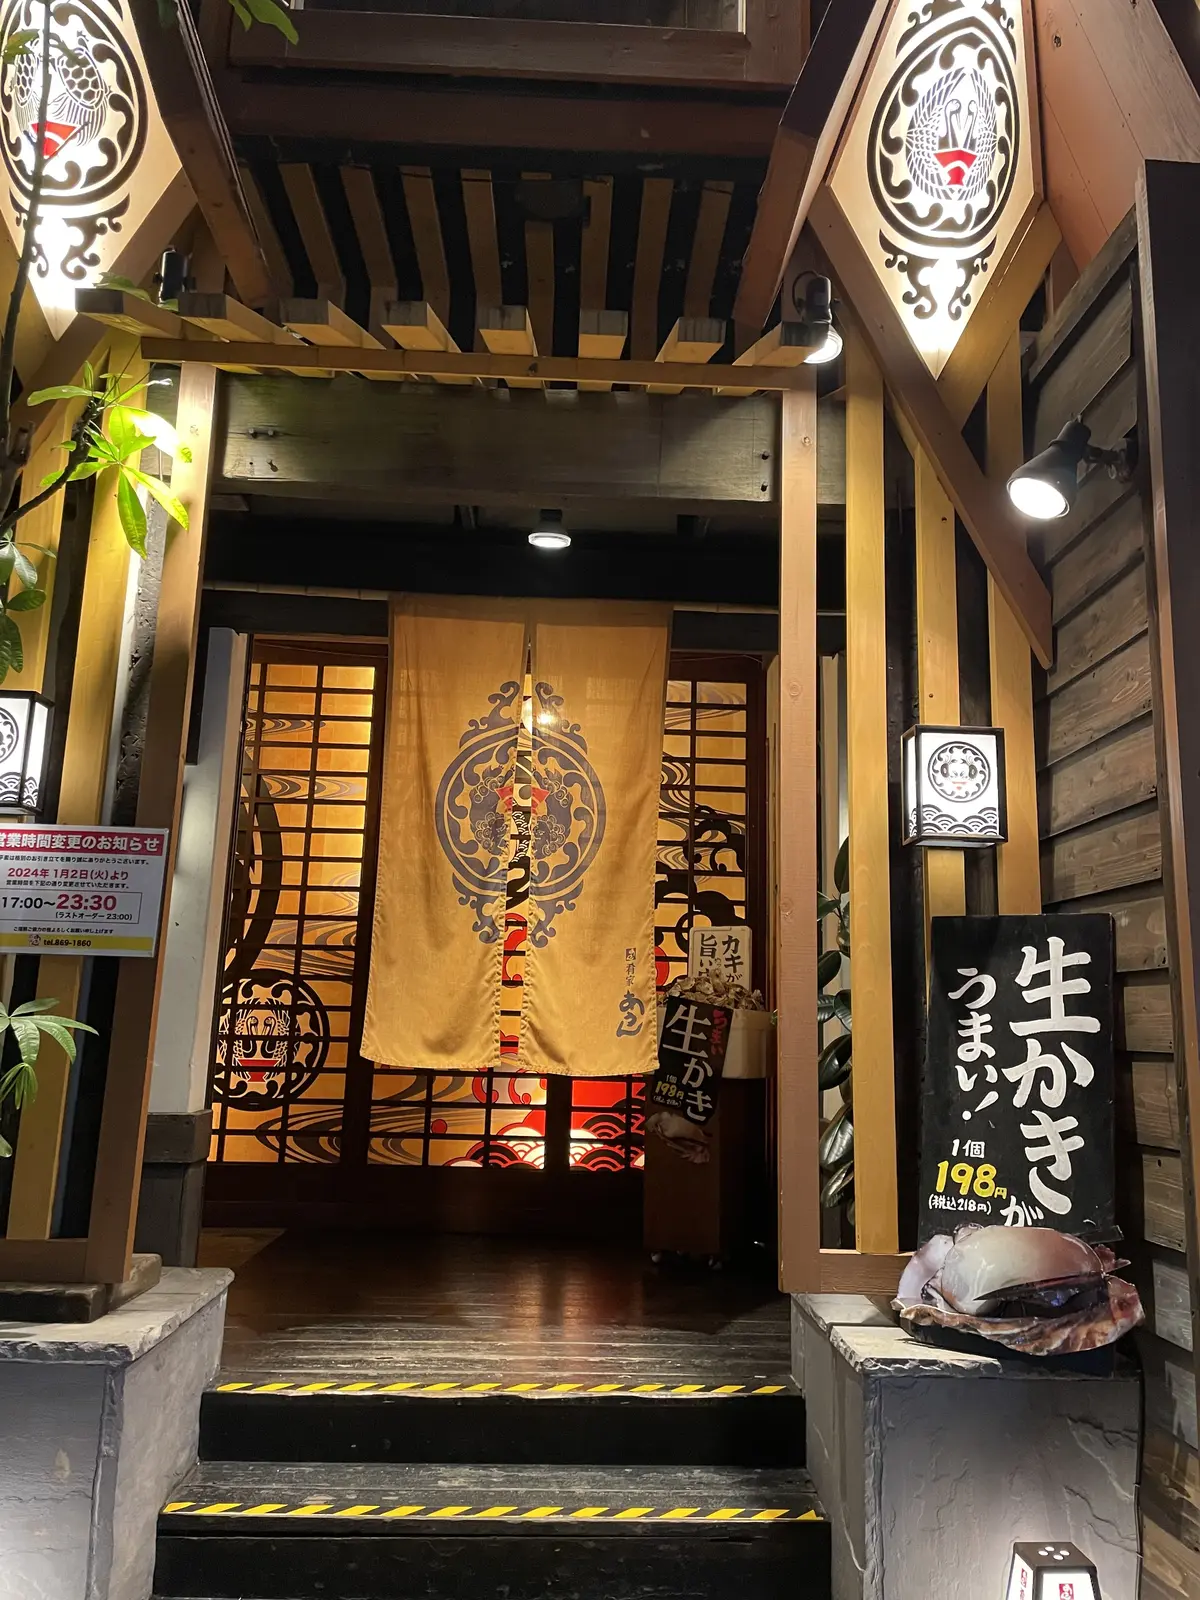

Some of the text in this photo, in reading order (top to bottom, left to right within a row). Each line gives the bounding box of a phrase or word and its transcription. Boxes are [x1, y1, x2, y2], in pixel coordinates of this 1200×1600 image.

[722, 935, 744, 982] カキが
[662, 1004, 714, 1122] 生かき
[948, 967, 999, 1121] うまい!
[952, 1138, 985, 1159] 1個
[935, 1160, 1008, 1200] 198円
[928, 1193, 992, 1215] (税込218円)
